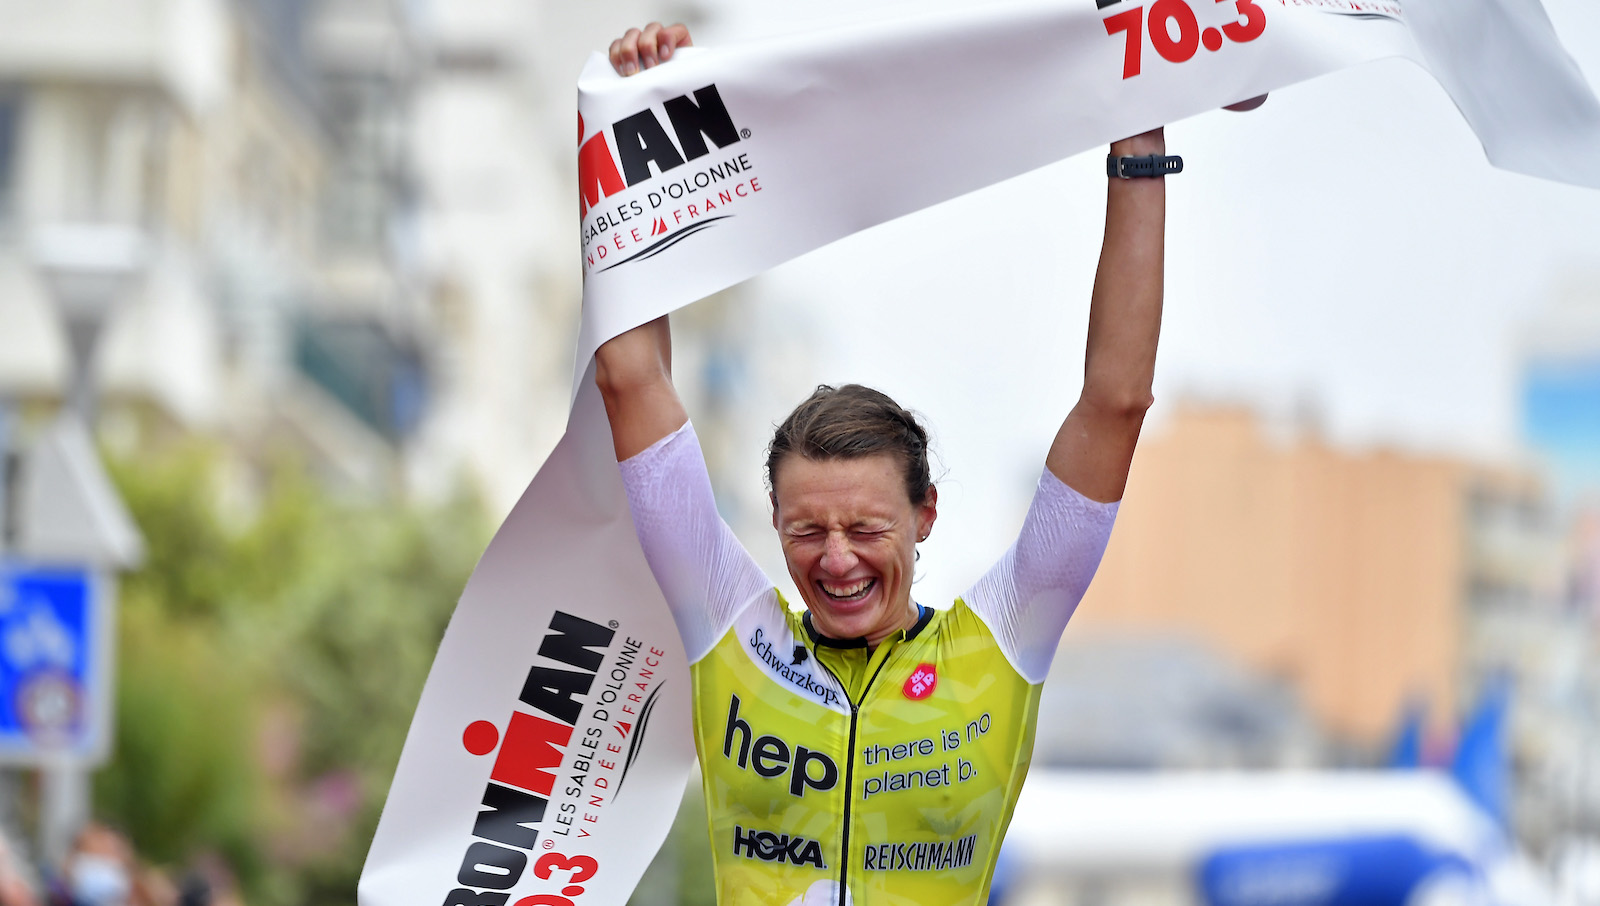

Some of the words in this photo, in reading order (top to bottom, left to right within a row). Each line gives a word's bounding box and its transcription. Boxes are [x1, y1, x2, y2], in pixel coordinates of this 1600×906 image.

[647, 153, 753, 209] D'OLONNE
[672, 177, 762, 225] FRANCE
[553, 802, 577, 837] LES
[565, 726, 604, 800] SABLES
[592, 636, 643, 723] D'OLONNE
[577, 743, 622, 839] VENDÉE
[622, 646, 665, 716] FRANCE
[724, 694, 838, 797] hep
[863, 739, 934, 765] there
[941, 728, 962, 752] is
[966, 712, 993, 743] no
[863, 763, 950, 799] planet
[957, 757, 980, 783] b.
[863, 833, 978, 872] REISCHMANN
